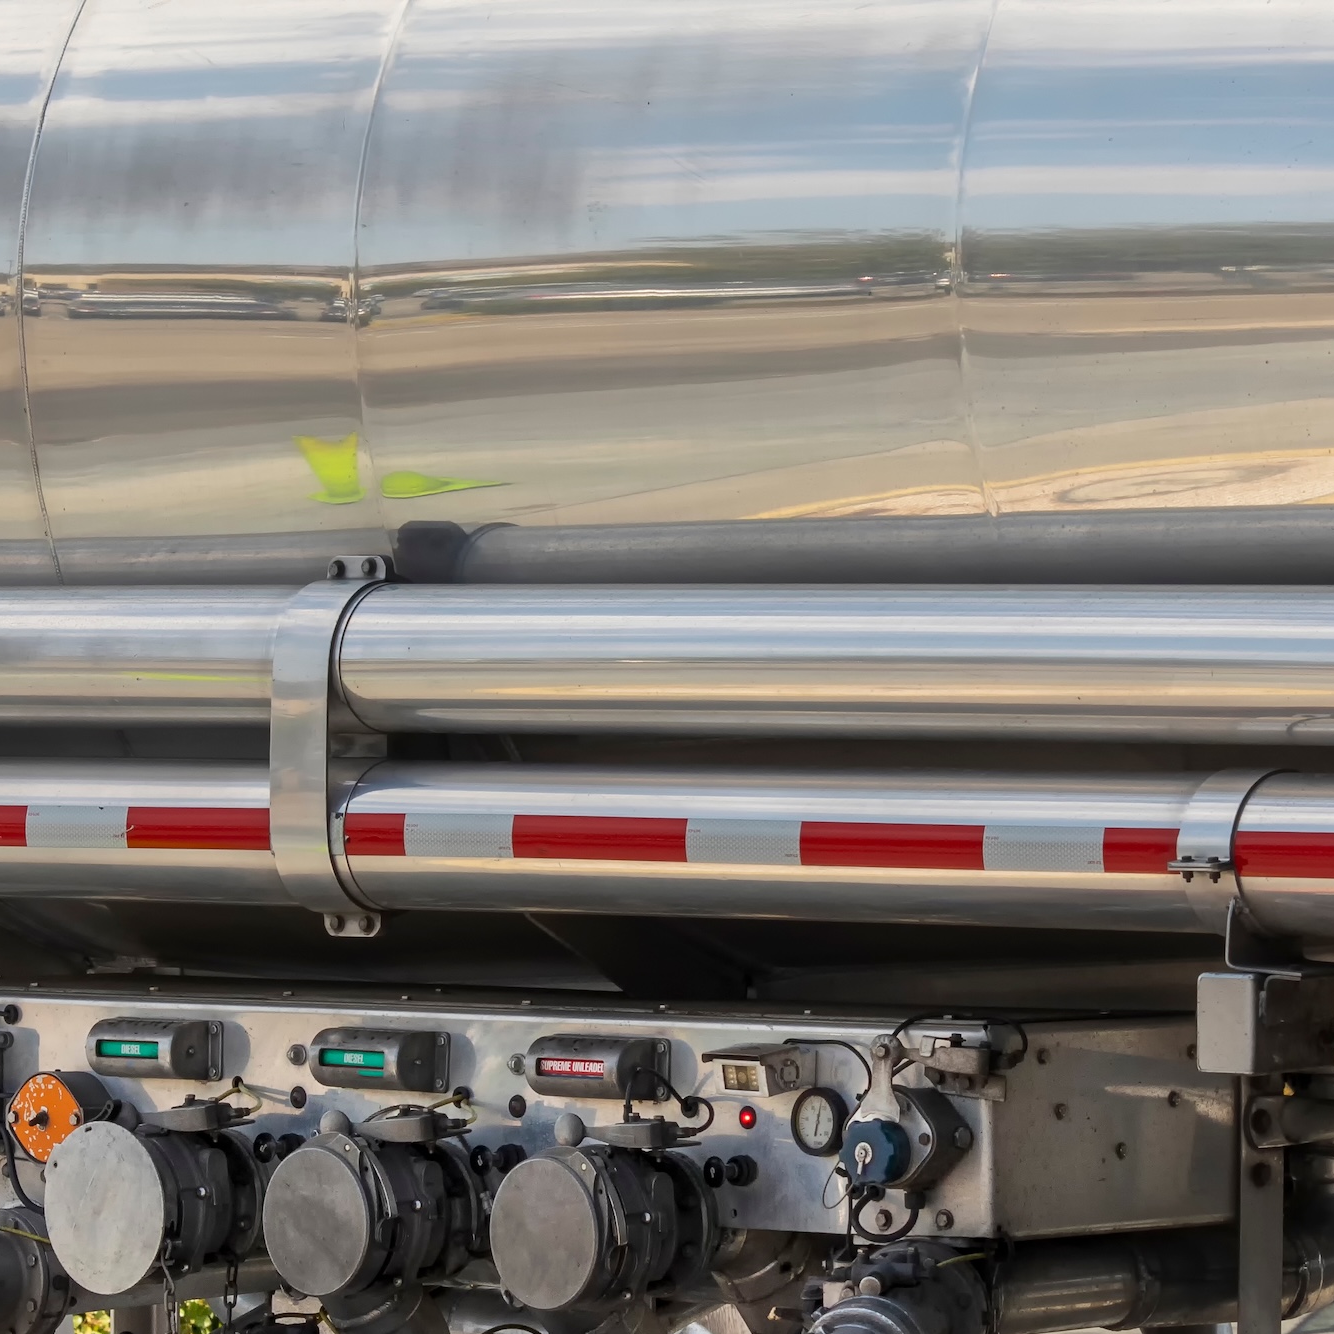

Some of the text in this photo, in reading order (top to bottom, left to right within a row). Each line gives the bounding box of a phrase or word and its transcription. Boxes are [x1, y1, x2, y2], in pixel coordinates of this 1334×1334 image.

[120, 1043, 141, 1055] DIESEL
[343, 1052, 365, 1065] DIESEL
[540, 1060, 572, 1072] SUPREME
